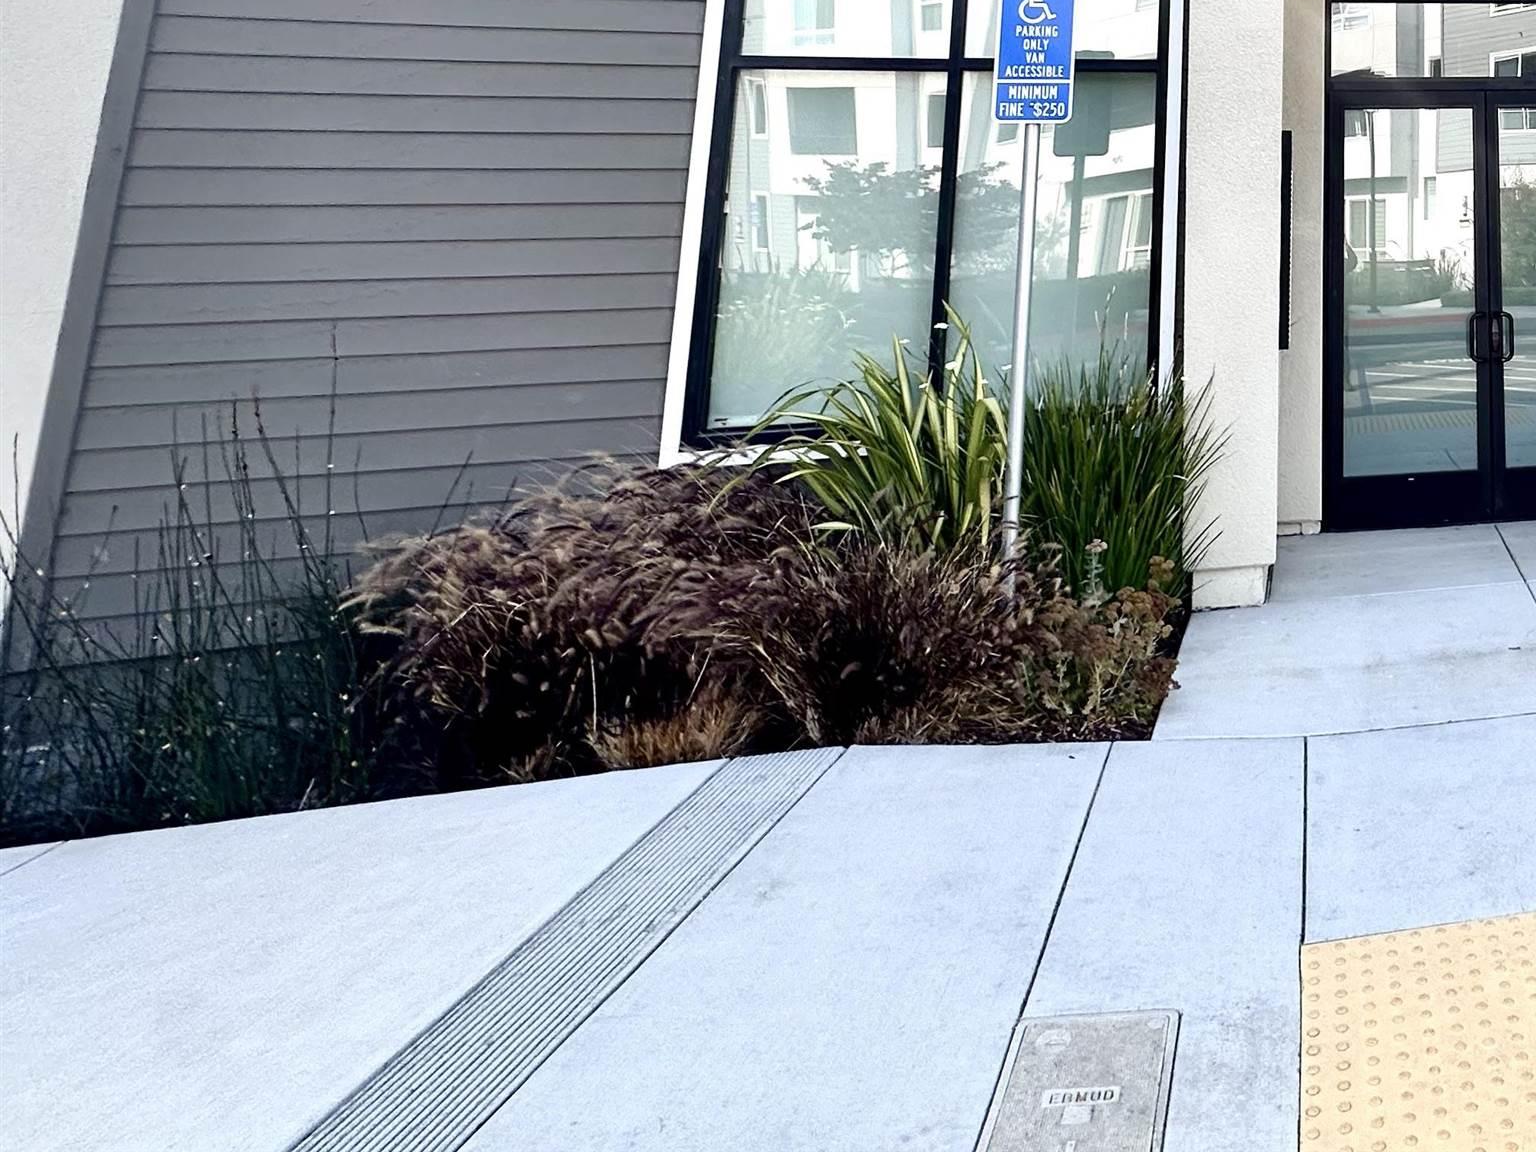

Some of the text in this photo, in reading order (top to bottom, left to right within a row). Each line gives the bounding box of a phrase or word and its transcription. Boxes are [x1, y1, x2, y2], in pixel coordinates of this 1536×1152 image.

[1015, 25, 1058, 37] PARKING
[1023, 39, 1049, 50] ONLY
[1025, 52, 1045, 64] VAN
[1005, 65, 1064, 78] ACCESSIBLE
[1008, 85, 1058, 100] MINIMUM
[999, 102, 1065, 118] FINE $250
